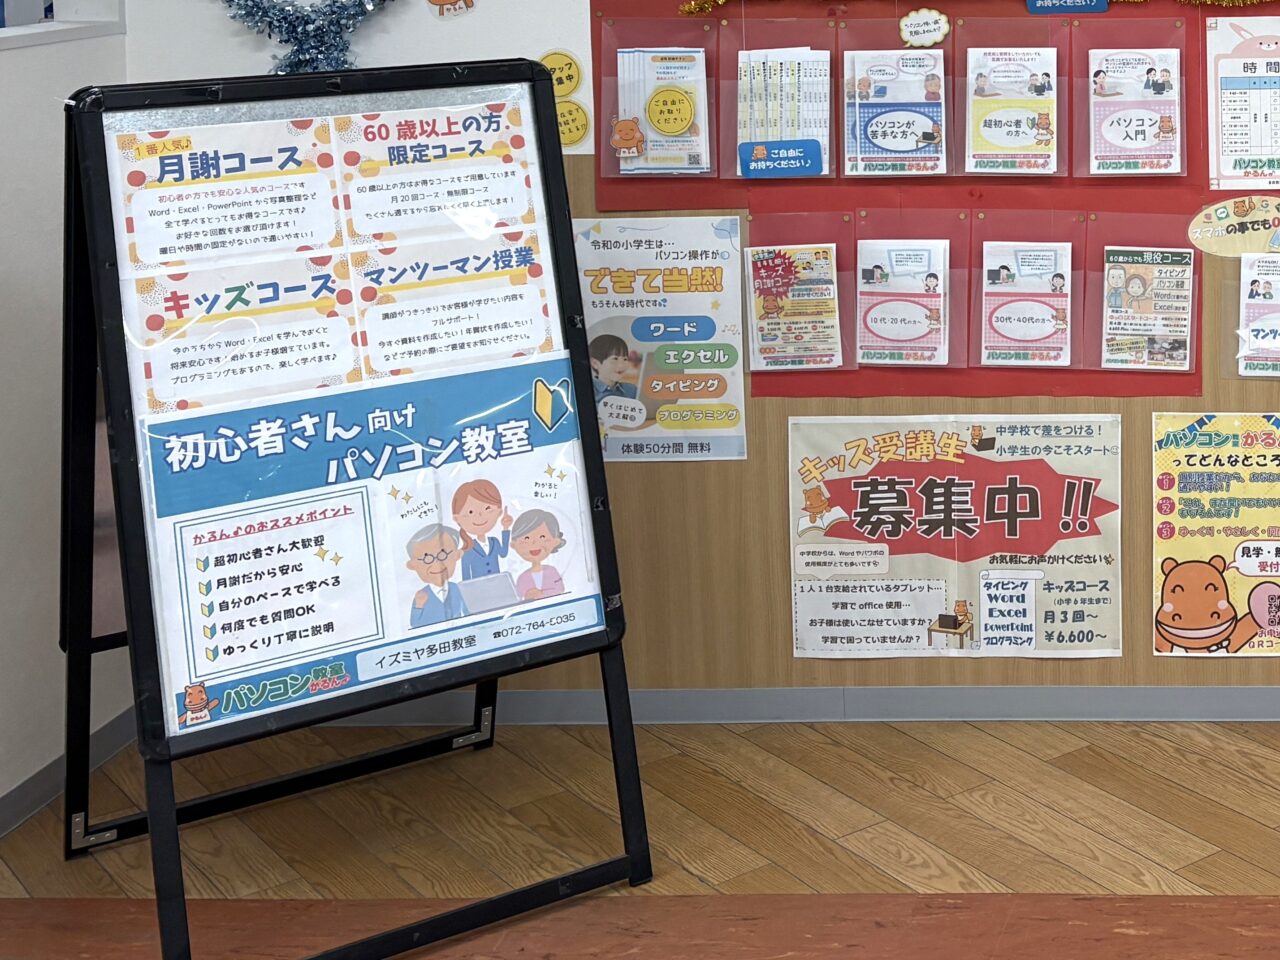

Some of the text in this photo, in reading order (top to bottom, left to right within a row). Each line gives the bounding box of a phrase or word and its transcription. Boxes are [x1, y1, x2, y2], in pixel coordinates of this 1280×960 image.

[870, 121, 915, 129] パソコンが
[983, 119, 1022, 128] 超初心者
[1110, 118, 1158, 127] パソコン
[870, 130, 918, 139] 苦手な方へ
[1123, 130, 1146, 141] 入門
[388, 140, 485, 166] 限定コース
[771, 149, 804, 157] ご自由に
[157, 147, 303, 183] 月謝コース
[158, 182, 306, 203] 初心者の方でも安心な人気のコースです
[655, 251, 719, 260] パソコン操作が
[364, 246, 535, 286] マンツーマン授業
[1158, 269, 1186, 277] タイピング
[164, 273, 336, 319] キッズコース
[591, 300, 658, 308] もうそんな時代です
[650, 322, 697, 336] ワード
[665, 350, 728, 363] エクセル
[651, 379, 719, 392] タイピング
[658, 410, 739, 421] プログラミング
[166, 404, 416, 474] 初心者さん 向け
[1163, 432, 1231, 448] パソコン
[327, 419, 533, 484] パソコン教室
[621, 443, 711, 454] 体験50分間 無料
[996, 445, 1110, 456] 小学生の今こそスタート
[799, 430, 967, 484] キッズ受講生
[214, 535, 324, 567] 超初心者さん大歓迎
[989, 554, 1102, 564] お気軽にお声がけください
[216, 563, 303, 589] 月謝だから安心
[984, 582, 1028, 590] タイピング
[1043, 581, 1109, 592] キッズコース
[219, 576, 341, 612] 自分のペースで学べる
[987, 594, 1025, 603] Word
[988, 608, 1027, 618] Excel
[221, 605, 315, 634] 何度でも質問OK
[985, 623, 1033, 632] PowerPoint
[223, 622, 334, 656] ゆっくり丁寧に説明
[822, 636, 920, 644] 学習で困っていませんか？
[984, 636, 1033, 646] プログラミング
[375, 636, 476, 669] イズミヤ多田教室
[222, 662, 345, 713] パソコン 教室
